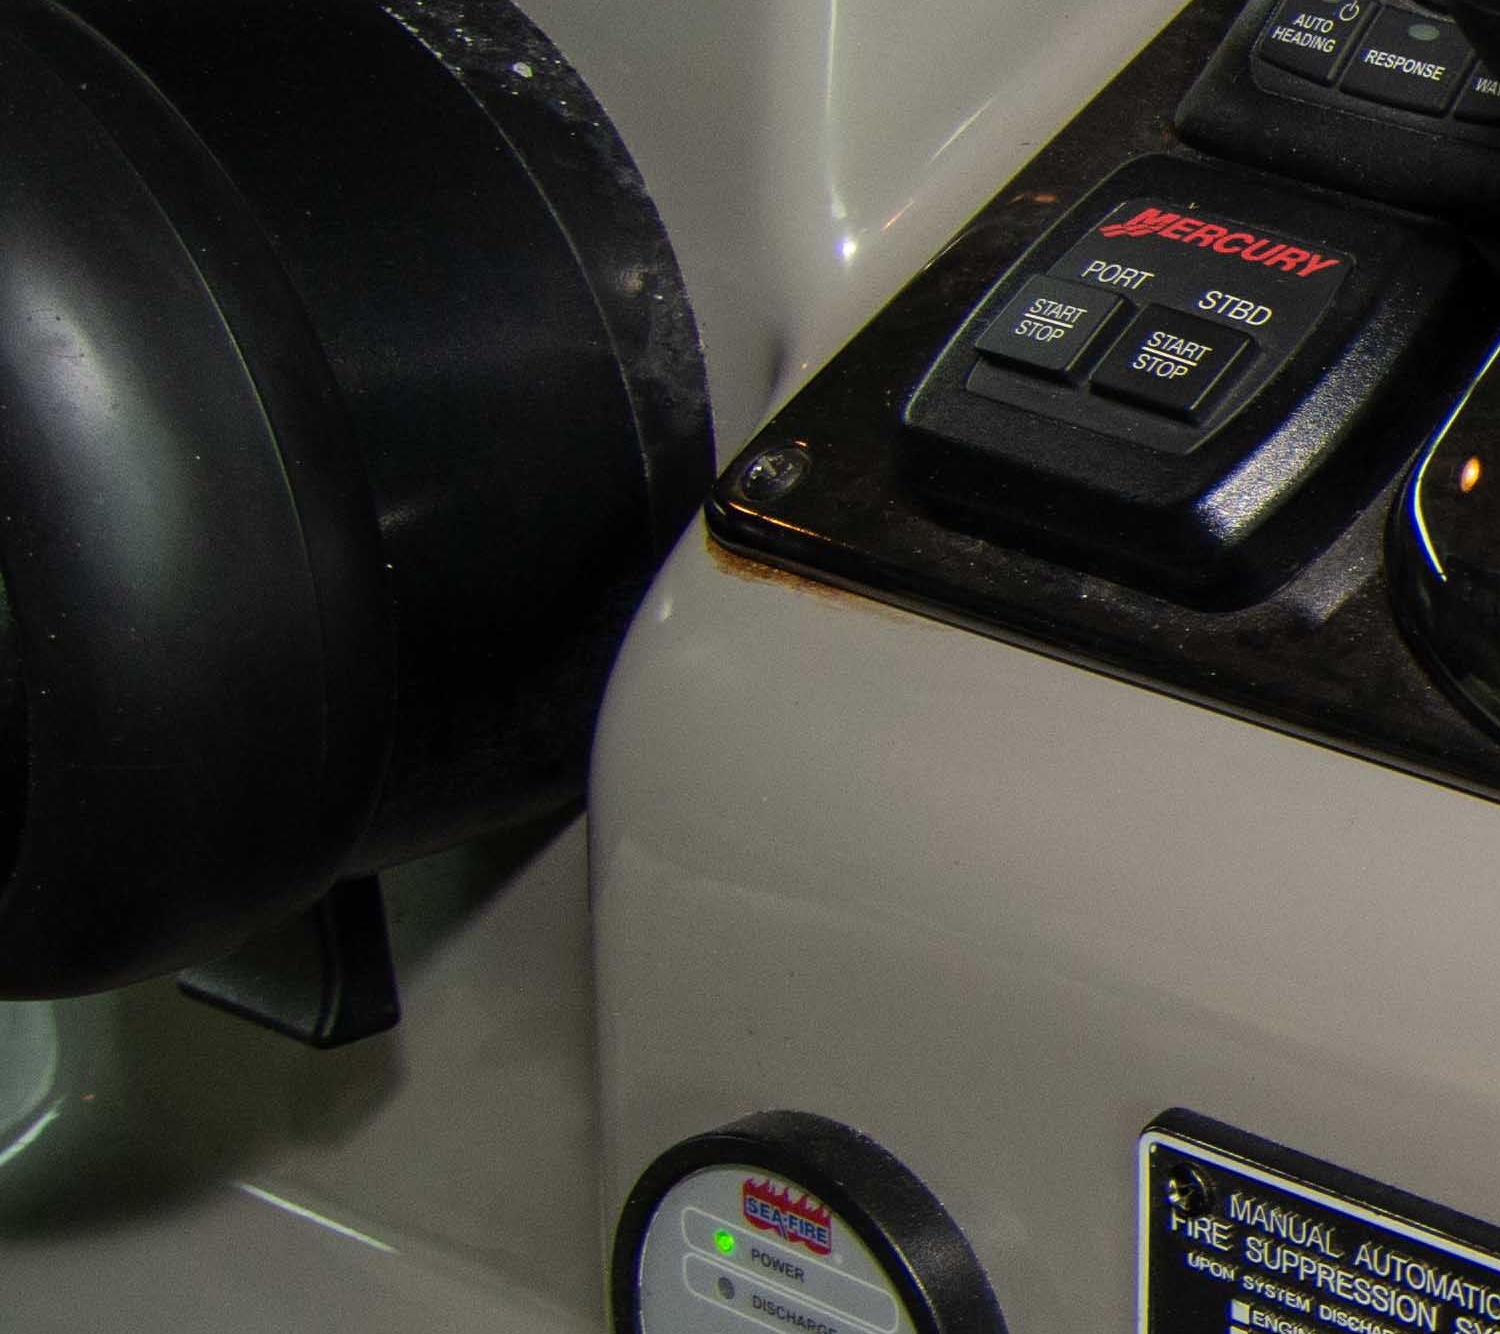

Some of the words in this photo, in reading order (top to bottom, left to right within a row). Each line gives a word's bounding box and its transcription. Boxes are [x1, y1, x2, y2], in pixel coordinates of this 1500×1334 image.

[1294, 11, 1334, 34] AUTO
[1272, 25, 1337, 54] HEADING
[1363, 48, 1446, 81] RESPONSE
[1100, 207, 1340, 278] MERCURY
[1080, 260, 1155, 291] PORT
[1028, 297, 1088, 323] START
[1198, 290, 1272, 327] STBD
[1014, 320, 1065, 343] STOP
[1146, 330, 1213, 361] START
[1131, 353, 1189, 382] STOP
[1229, 1193, 1341, 1259] MANUAL
[751, 1247, 805, 1284] POWER
[1170, 1209, 1230, 1252] FIRE
[1245, 1235, 1437, 1333] SUPPRESSION
[1186, 1253, 1233, 1283] UPON
[1242, 1274, 1310, 1314] SYSTEM
